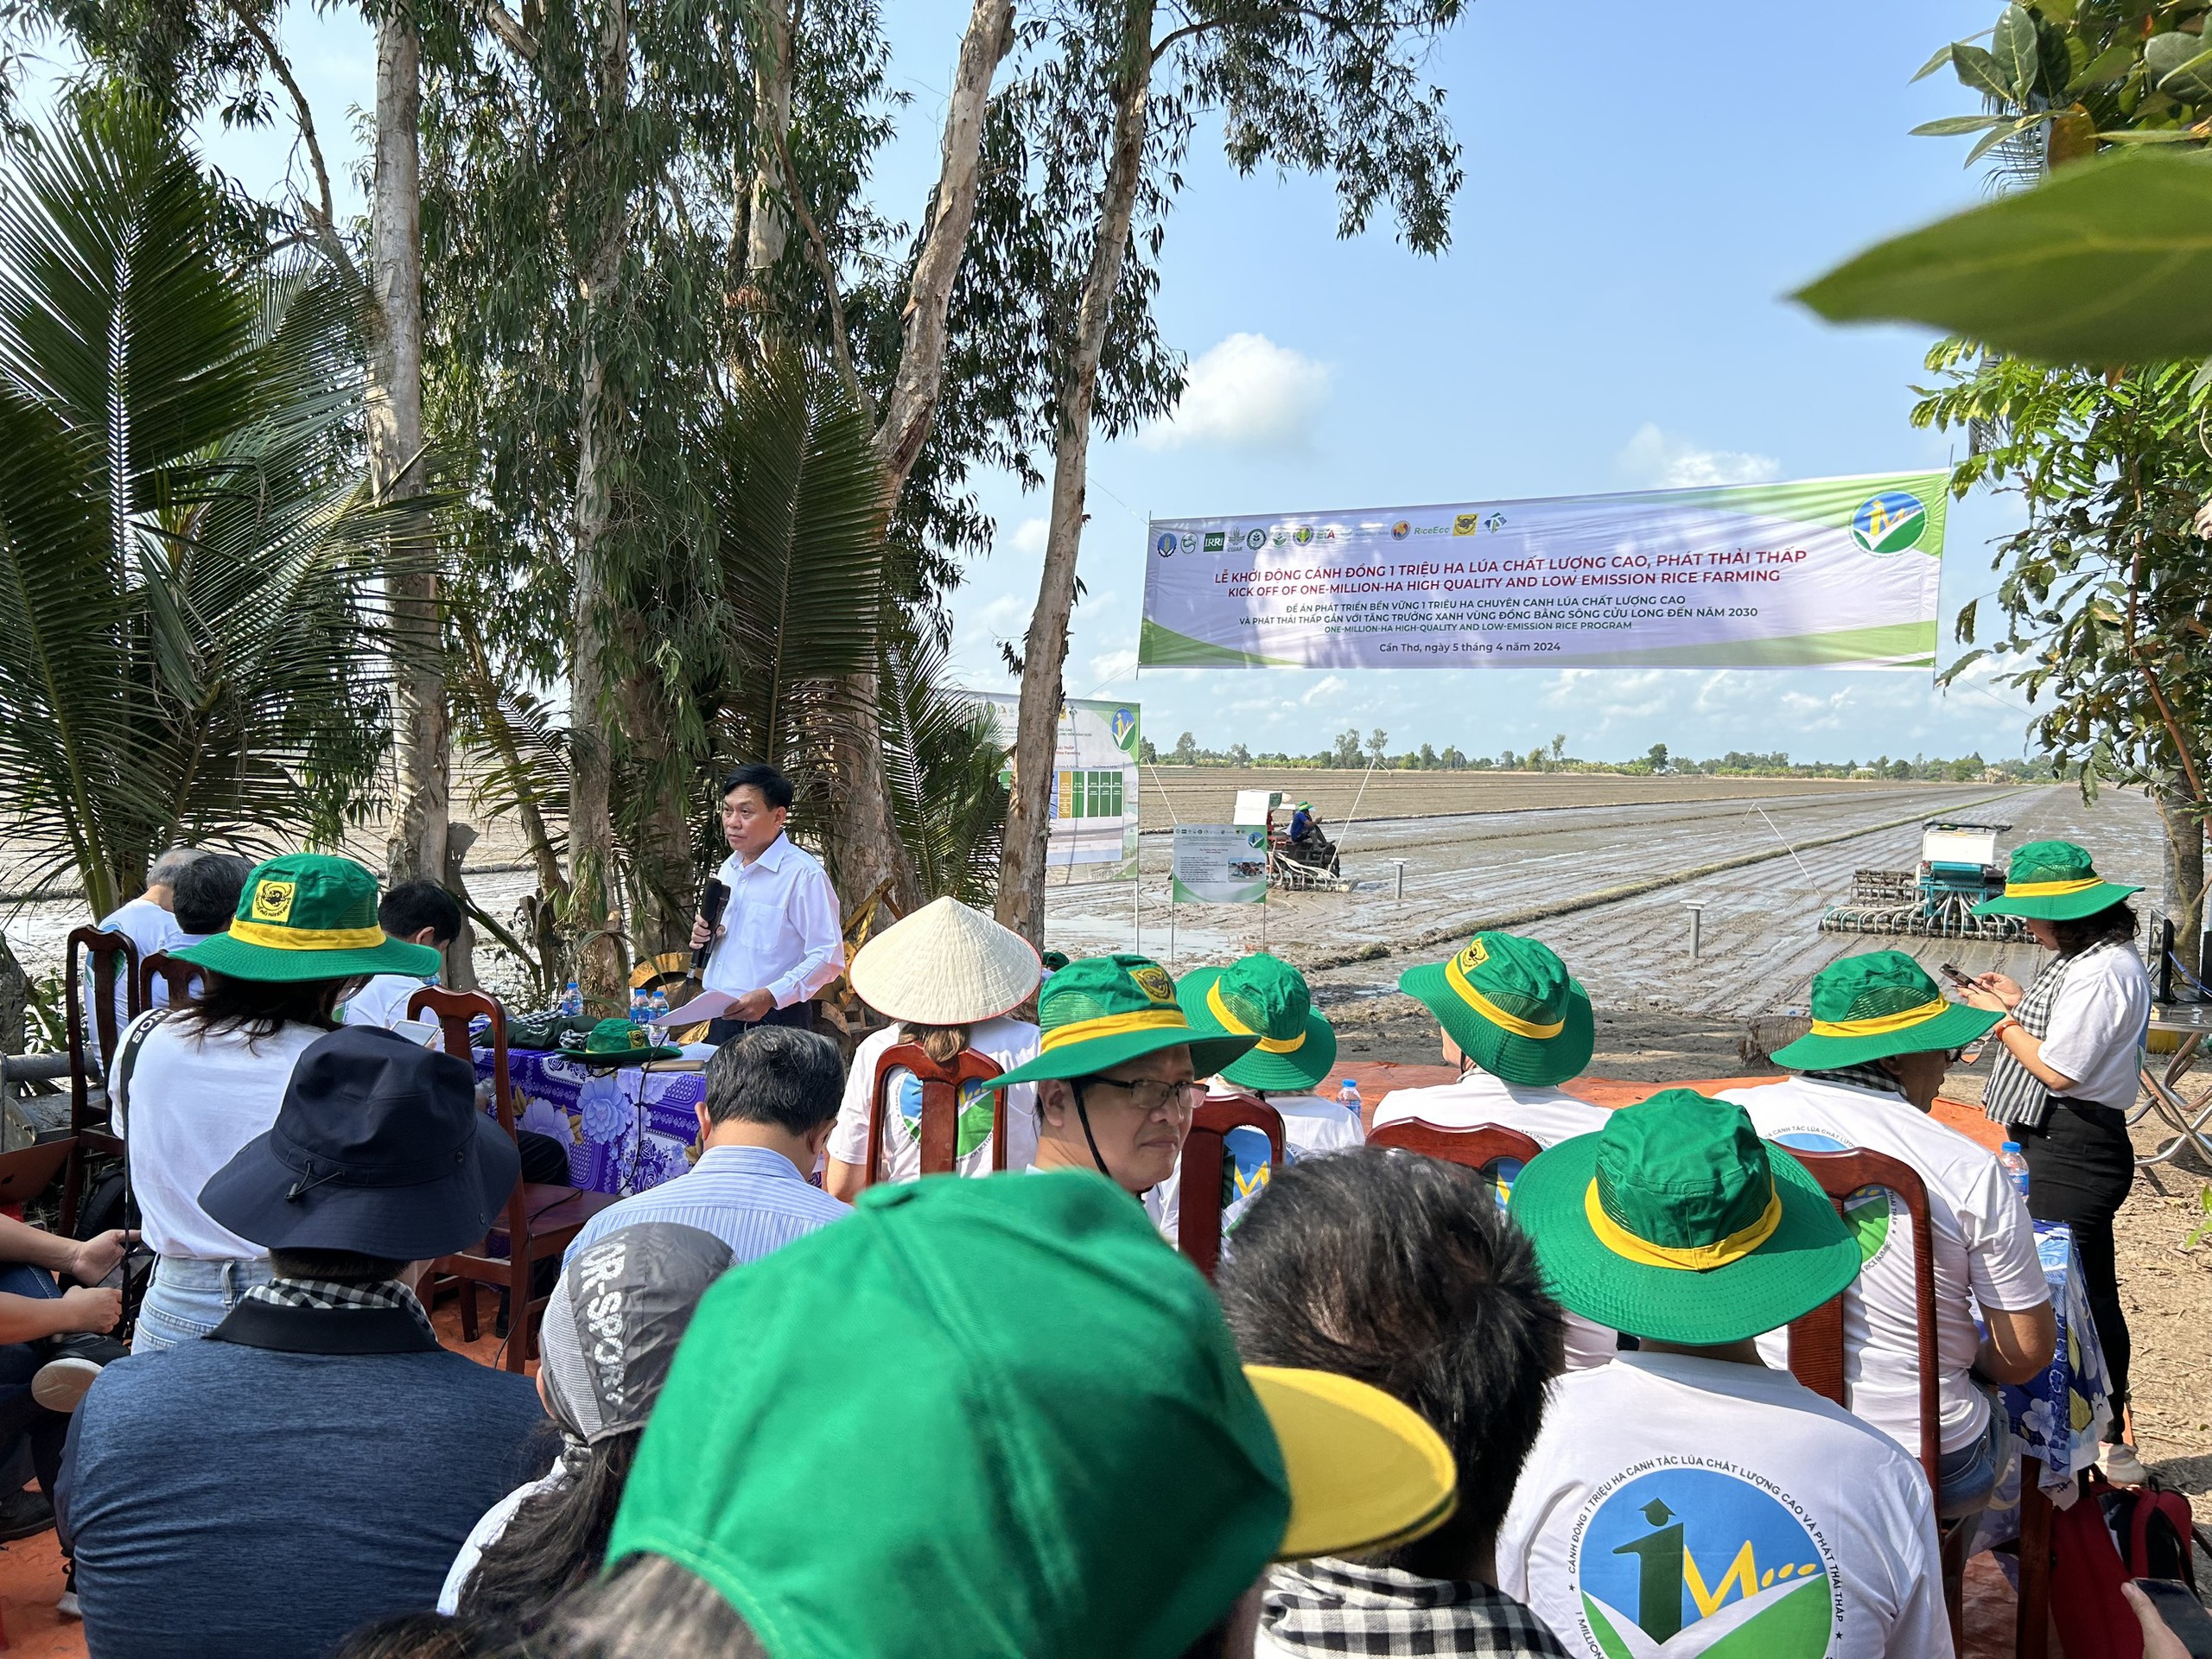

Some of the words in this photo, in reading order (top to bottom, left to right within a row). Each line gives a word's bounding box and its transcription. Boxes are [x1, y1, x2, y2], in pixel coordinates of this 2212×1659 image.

[1414, 526, 1450, 535] RiceEco
[1205, 537, 1224, 547] IRRI
[1215, 569, 1228, 583] LỄ
[1231, 569, 1261, 583] KHỞI
[1264, 569, 1301, 585] ĐỘNG
[1305, 566, 1341, 581] CÁNH
[1344, 563, 1386, 578] ĐỒNG
[1390, 566, 1395, 576] 1
[1399, 562, 1440, 578] TRIỆU
[1444, 563, 1465, 574] HA
[1469, 558, 1498, 573] LÚA
[1503, 556, 1545, 572] CHẤT
[1549, 556, 1606, 571] LƯỢNG
[1611, 556, 1650, 569] CAO,
[1656, 551, 1703, 567] PHÁT
[1708, 548, 1751, 565] THẢI
[1756, 547, 1807, 563] THẤP
[1228, 588, 1254, 597] KICK
[1256, 587, 1278, 596] OFF
[1281, 586, 1297, 595] OF
[1300, 582, 1402, 595] ONE-MILLION-HA
[1407, 580, 1440, 590] HIGH
[1444, 577, 1503, 591] QUALITY
[1506, 576, 1537, 588] AND
[1542, 575, 1577, 587] LOW
[1581, 573, 1656, 586] EMISSION
[1661, 572, 1698, 584] RICE
[1702, 570, 1780, 583] FARMING
[1300, 602, 1313, 613] ÁN
[1315, 601, 1338, 612] PHÁT
[1392, 600, 1419, 610] VỮNG
[1428, 599, 1455, 610] TRIỆU
[1477, 597, 1520, 608] CHUYÊN
[1522, 598, 1554, 607] CANH
[1557, 596, 1579, 607] LÚA
[1582, 594, 1612, 606] CHẤT
[1616, 594, 1656, 607] LƯỢNG
[1660, 595, 1685, 605] CAO
[1239, 615, 1250, 626] VÀ
[1252, 615, 1274, 625] PHÁT
[1276, 614, 1296, 625] THẢI
[1299, 613, 1322, 624] THẤP
[1345, 613, 1362, 623] VỚI
[1364, 612, 1389, 622] TĂNG
[1392, 611, 1433, 622] TRƯỞNG
[1435, 612, 1464, 621] XANH
[1466, 610, 1496, 620] VÙNG
[1498, 608, 1530, 620] ĐỒNG
[1534, 607, 1565, 619] BẰNG
[1568, 607, 1600, 619] SÔNG
[1603, 606, 1628, 618] CỬU
[1631, 608, 1664, 618] LONG
[1667, 606, 1693, 618] ĐẾN
[1696, 606, 1725, 617] NĂM
[1728, 607, 1758, 617] 2030
[1325, 625, 1393, 633] ONE-MILLION-HA
[1395, 623, 1458, 632] HIGH-QUALITY
[1482, 622, 1553, 631] LOW-EMISSION
[1580, 621, 1632, 630] PROGRAM
[1425, 643, 1450, 653] ngày
[1452, 643, 1459, 652] 5
[1461, 642, 1493, 653] tháng
[1496, 643, 1503, 652] 4
[1506, 642, 1530, 652] năm
[1533, 642, 1561, 652] 2024
[132, 1010, 166, 1043] SON
[1611, 1472, 1627, 1486] HA
[1626, 1459, 1655, 1476] CANH
[1656, 1455, 1678, 1467] TÁC
[1739, 1468, 1781, 1496] LƯỢNG
[1781, 1493, 1804, 1516] CAO
[1802, 1514, 1817, 1532] VÀ
